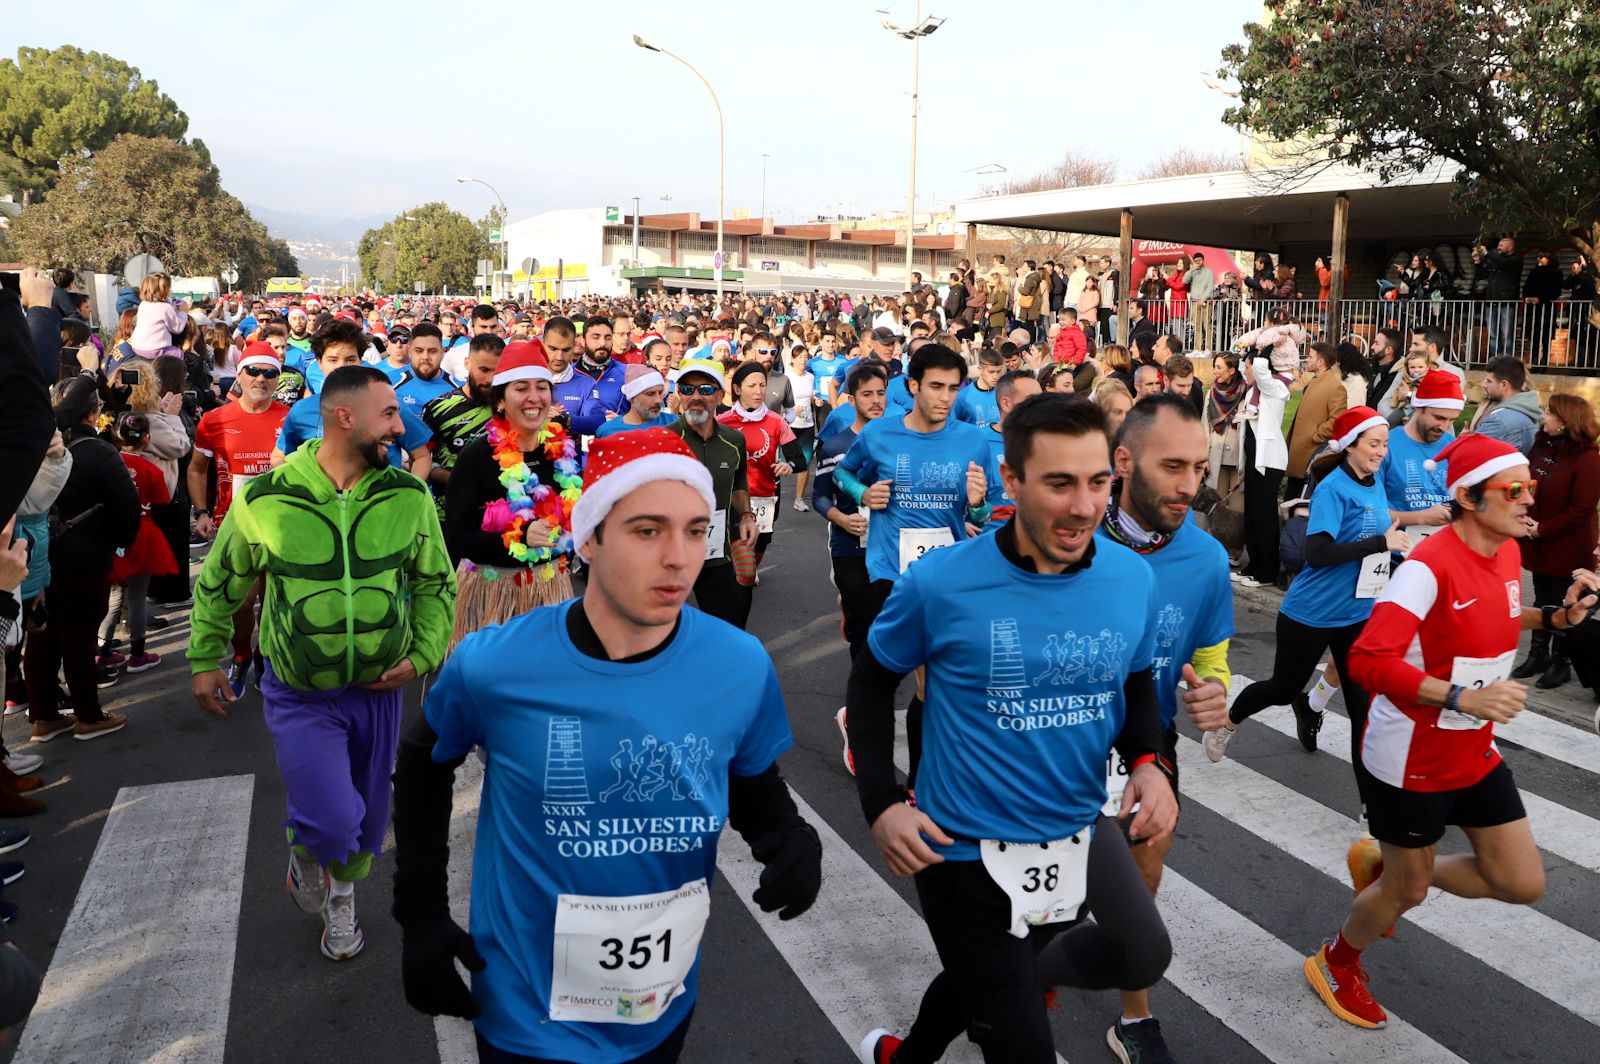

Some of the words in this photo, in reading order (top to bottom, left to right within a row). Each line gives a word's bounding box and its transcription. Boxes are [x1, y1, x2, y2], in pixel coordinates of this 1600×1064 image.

[896, 492, 913, 501] SAN
[914, 493, 960, 502] SILVESTRE
[1405, 493, 1422, 501] SAN
[899, 500, 954, 510] CORDOBESA
[986, 689, 1023, 699] XXXIX
[987, 700, 1026, 716] SAN
[1029, 690, 1117, 714] SILVESTRE
[996, 707, 1106, 732] CORDOBESA
[542, 804, 587, 816] XXXIX
[545, 818, 591, 838] SAN
[598, 815, 721, 837] SILVESTRE
[557, 836, 704, 858] CORDOBESA
[1021, 863, 1060, 893] 38
[584, 903, 603, 912] SAN
[605, 902, 656, 912] SILVESTRE
[598, 928, 672, 971] 351
[570, 995, 613, 1008] IMDECO
